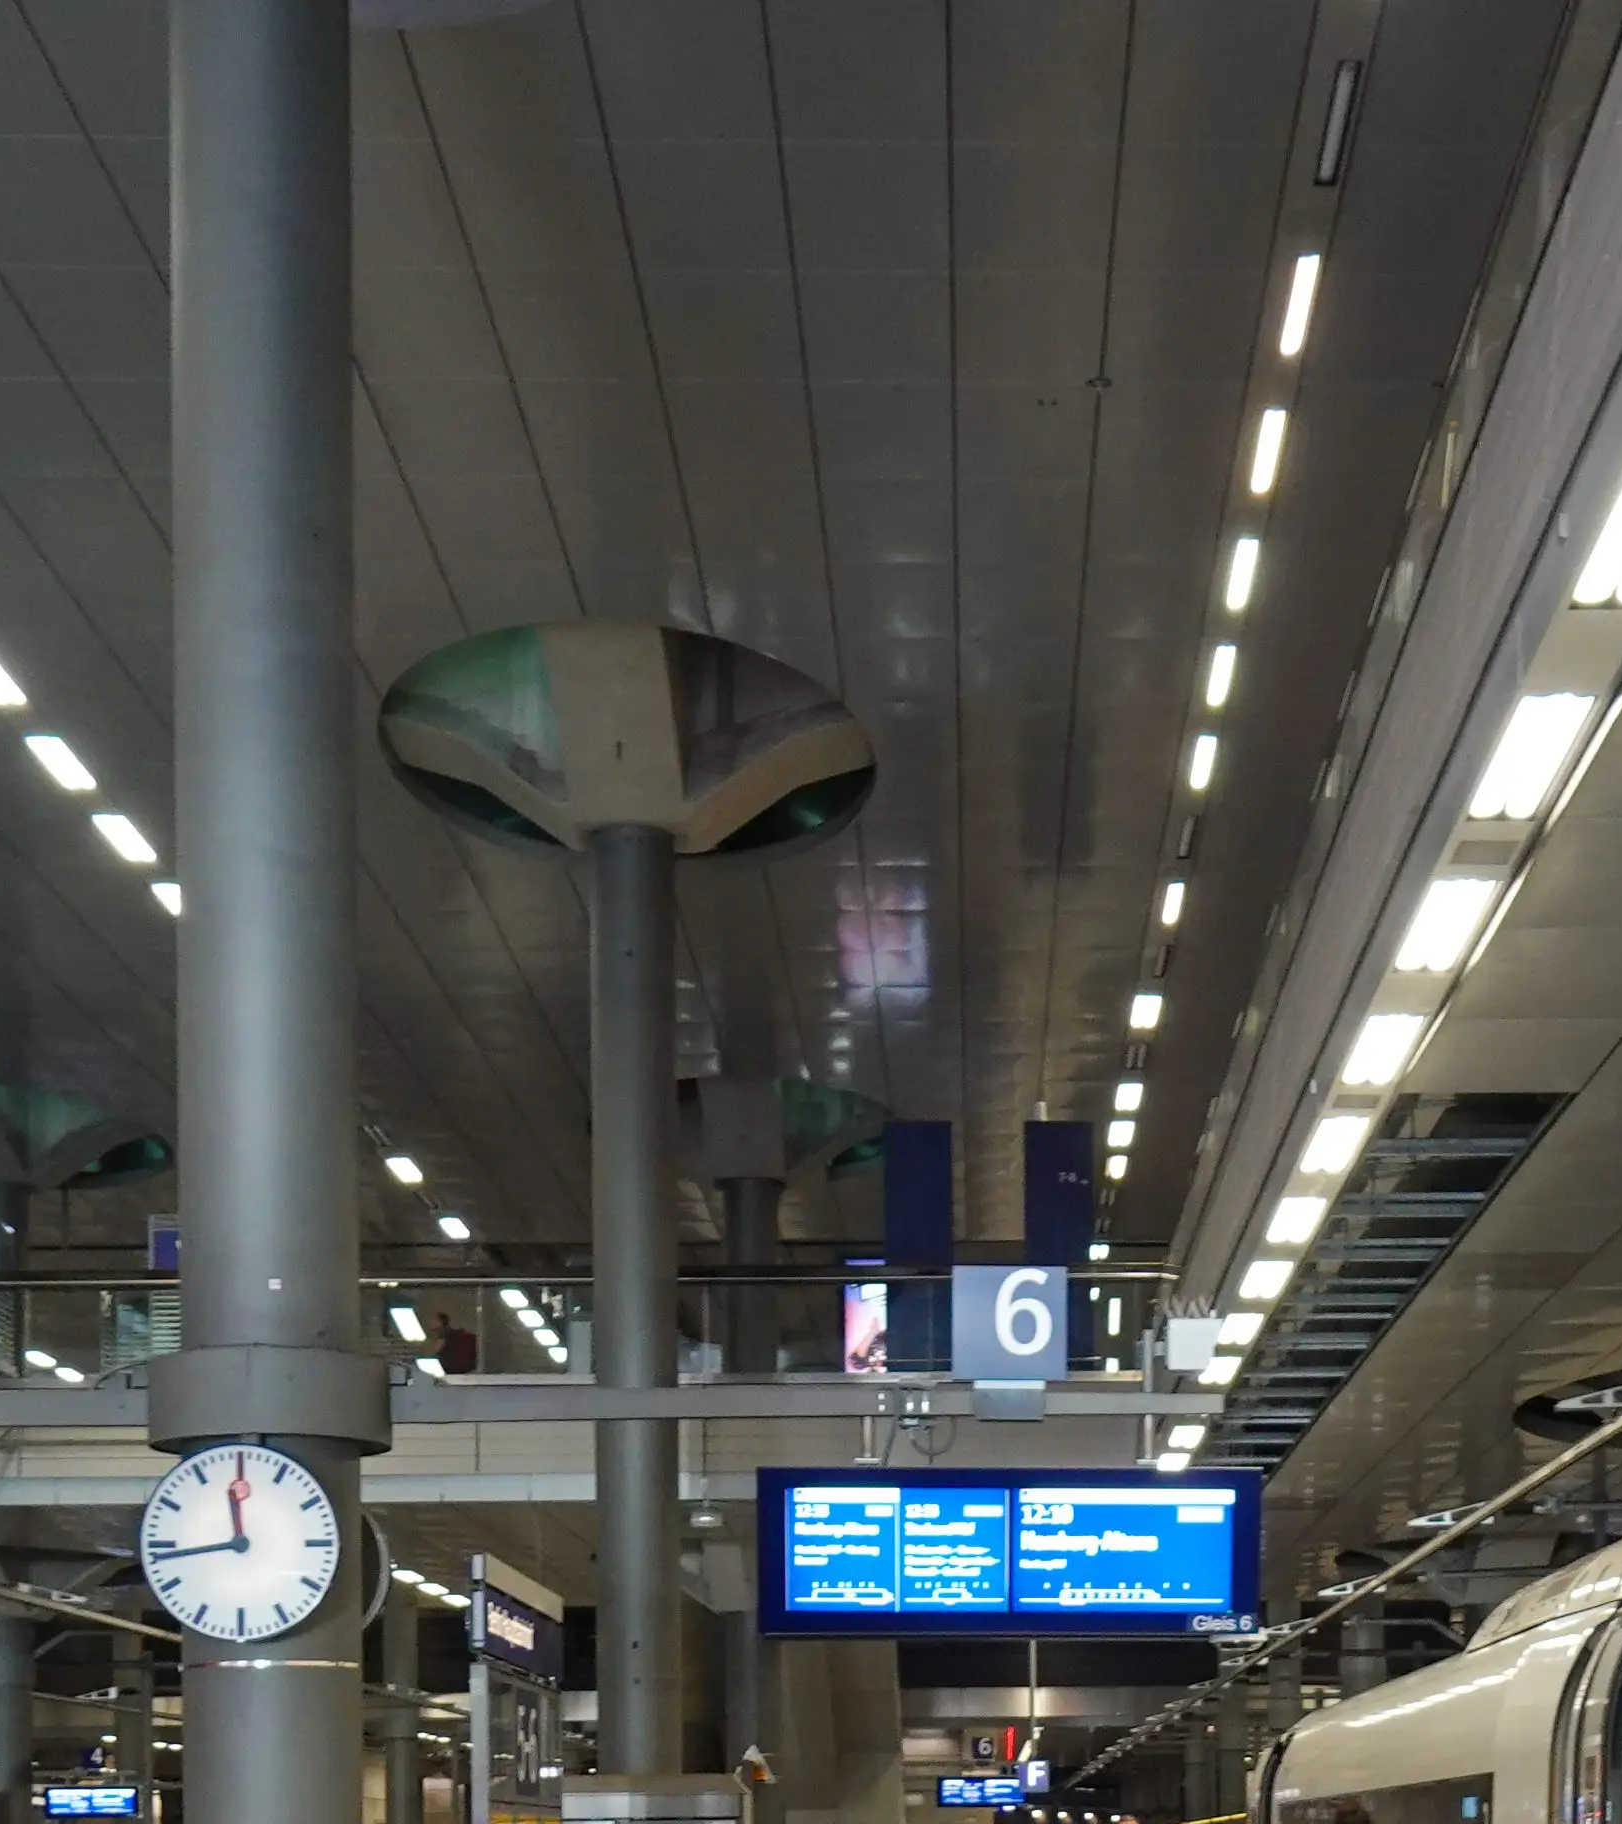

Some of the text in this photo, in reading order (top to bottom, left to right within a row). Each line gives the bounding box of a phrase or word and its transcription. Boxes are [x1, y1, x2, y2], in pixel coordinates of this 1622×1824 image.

[995, 1268, 1052, 1356] 6
[1192, 1615, 1253, 1632] Gleis 6
[978, 1737, 993, 1755] 6
[90, 1747, 103, 1765] 4
[1027, 1761, 1047, 1787] F
